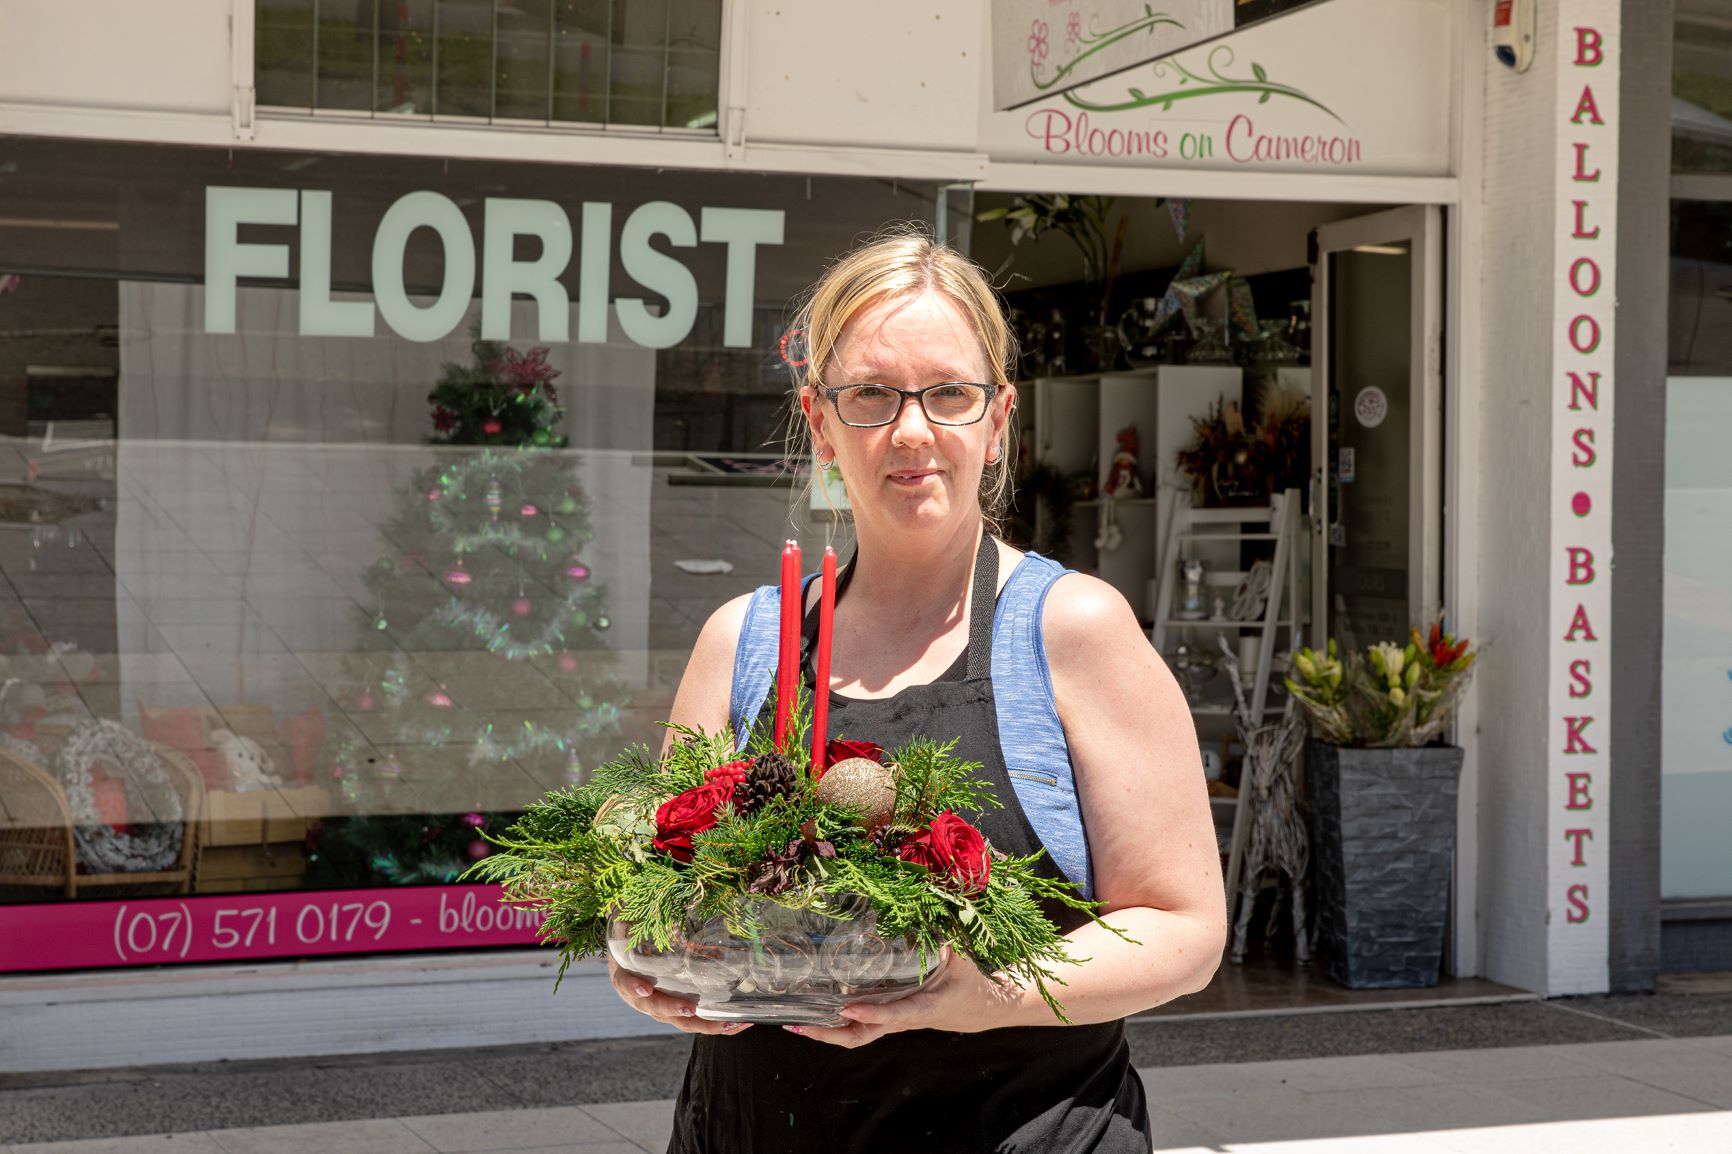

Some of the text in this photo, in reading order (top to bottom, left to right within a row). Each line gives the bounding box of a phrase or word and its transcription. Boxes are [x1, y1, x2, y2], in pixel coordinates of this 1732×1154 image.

[1025, 109, 1362, 164] Blooms on Cameron
[204, 185, 786, 350] FLORIST
[1563, 27, 1604, 924] BALLOONS BASKETS
[113, 902, 193, 961] (07)
[211, 906, 277, 949] 571
[295, 900, 392, 945] 0179
